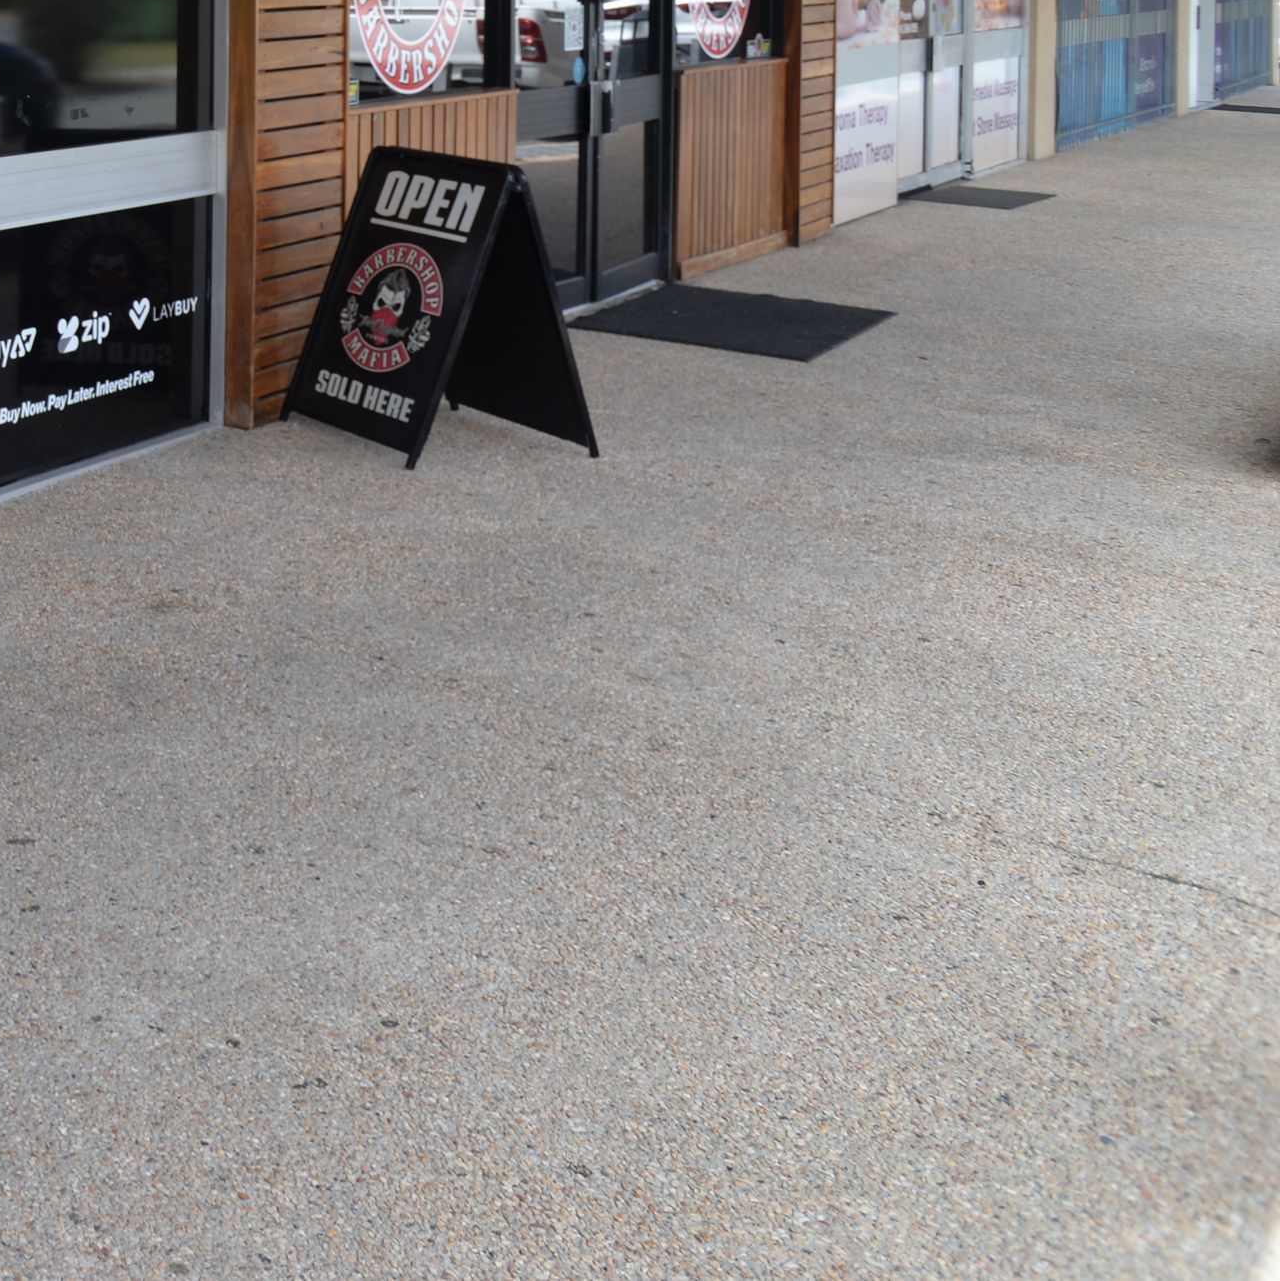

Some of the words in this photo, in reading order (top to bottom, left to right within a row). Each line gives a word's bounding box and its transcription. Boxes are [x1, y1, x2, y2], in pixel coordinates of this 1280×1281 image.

[835, 110, 857, 132] roma
[374, 169, 486, 234] OPEN
[353, 244, 440, 309] BARBERSHOP
[81, 310, 111, 345] zip
[152, 296, 199, 323] LAYBUY
[347, 334, 403, 368] MAFIA
[20, 400, 47, 419] Now.
[46, 393, 69, 411] Pay
[67, 385, 96, 405] Later.
[95, 374, 135, 397] Interest
[132, 369, 155, 388] Free
[314, 368, 364, 405] SOLD
[362, 383, 416, 424] HERE
